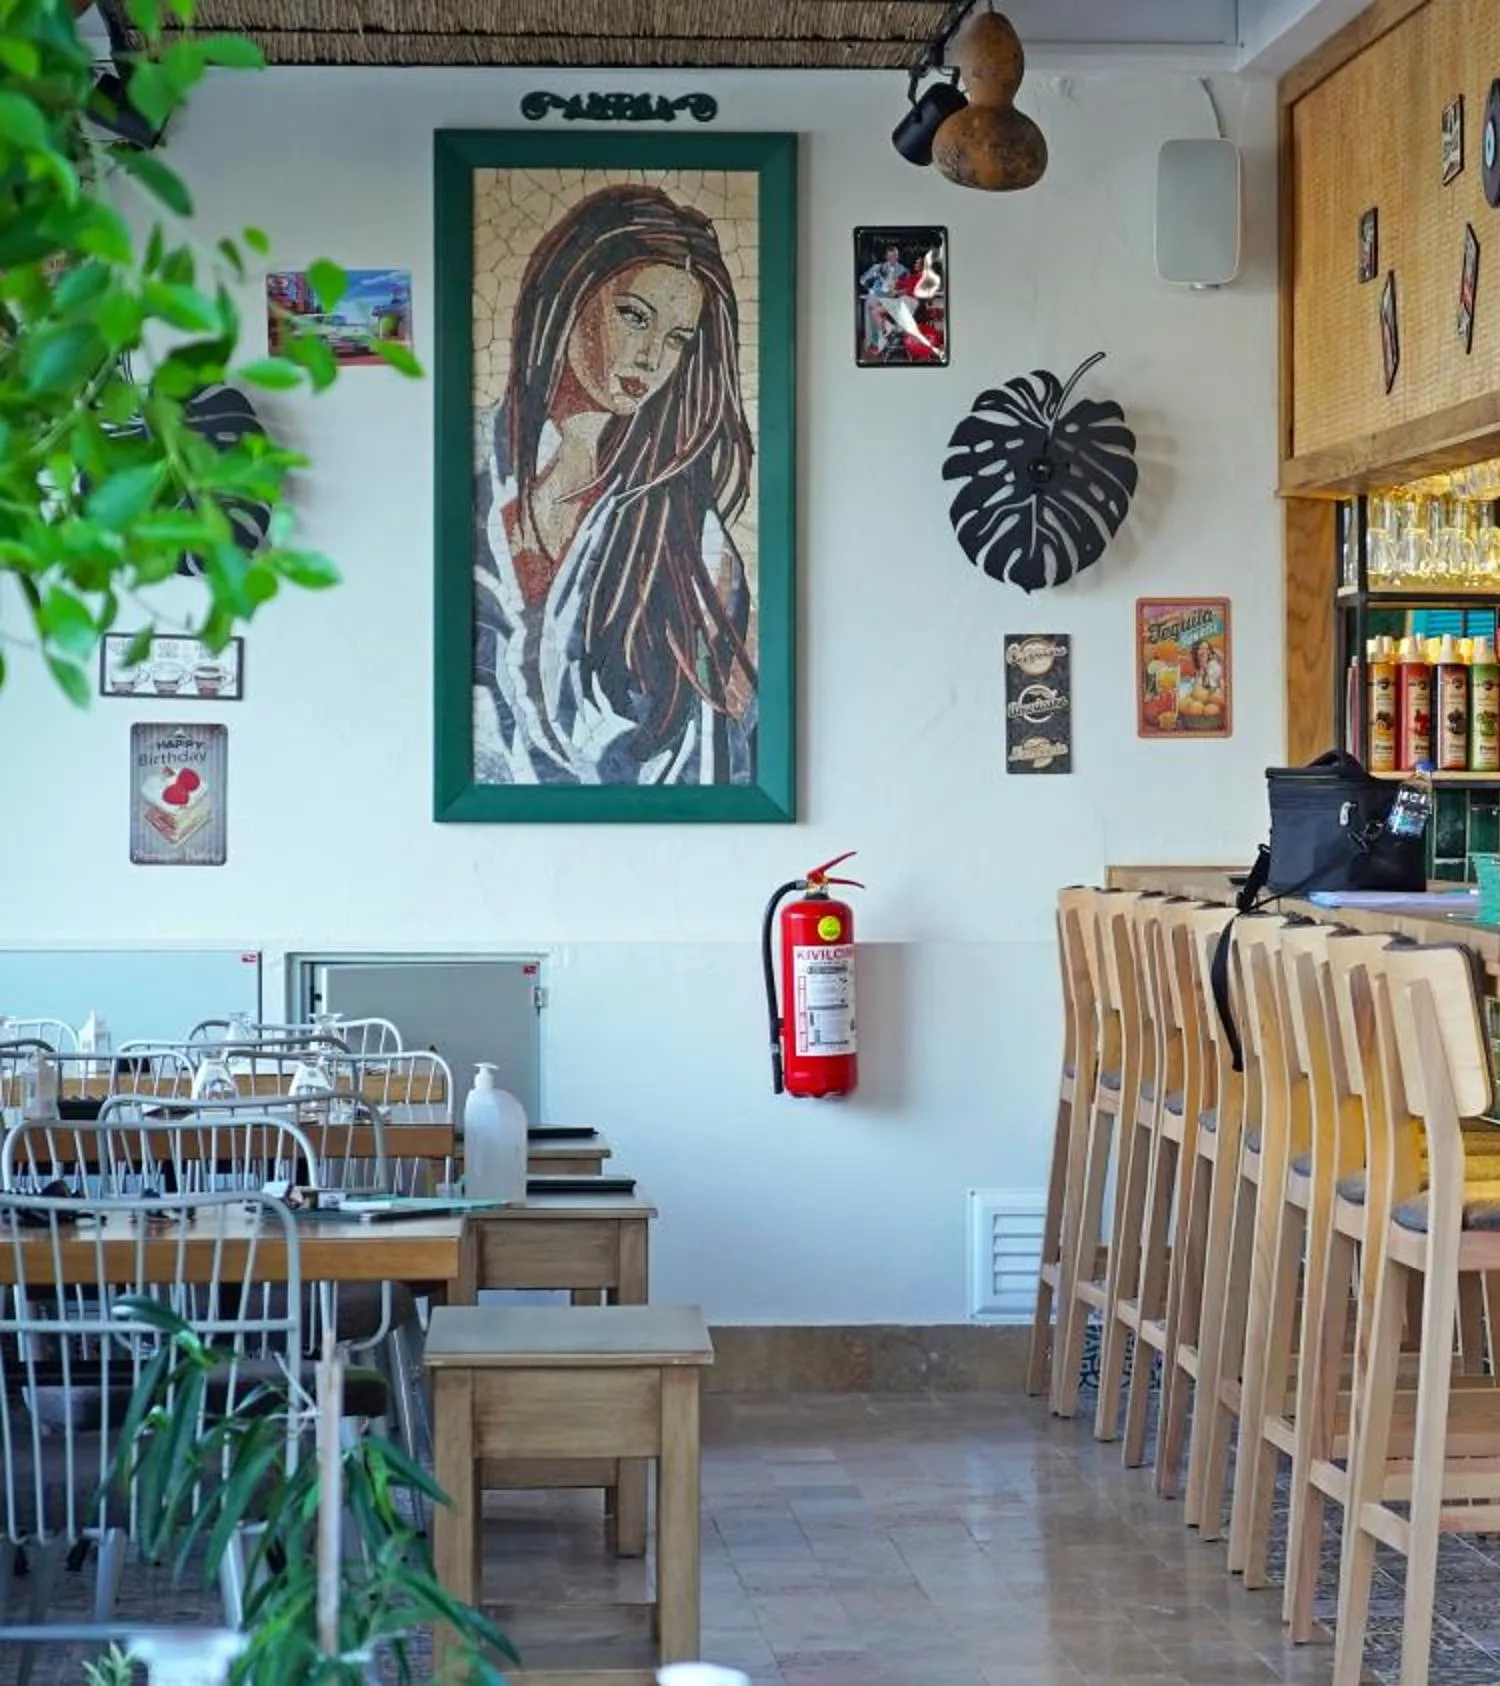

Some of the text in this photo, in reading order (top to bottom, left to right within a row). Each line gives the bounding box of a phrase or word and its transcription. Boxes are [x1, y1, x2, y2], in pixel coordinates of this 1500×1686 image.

[1148, 608, 1216, 644] Tequila
[157, 739, 205, 750] HAPPY
[138, 750, 207, 767] Birthday
